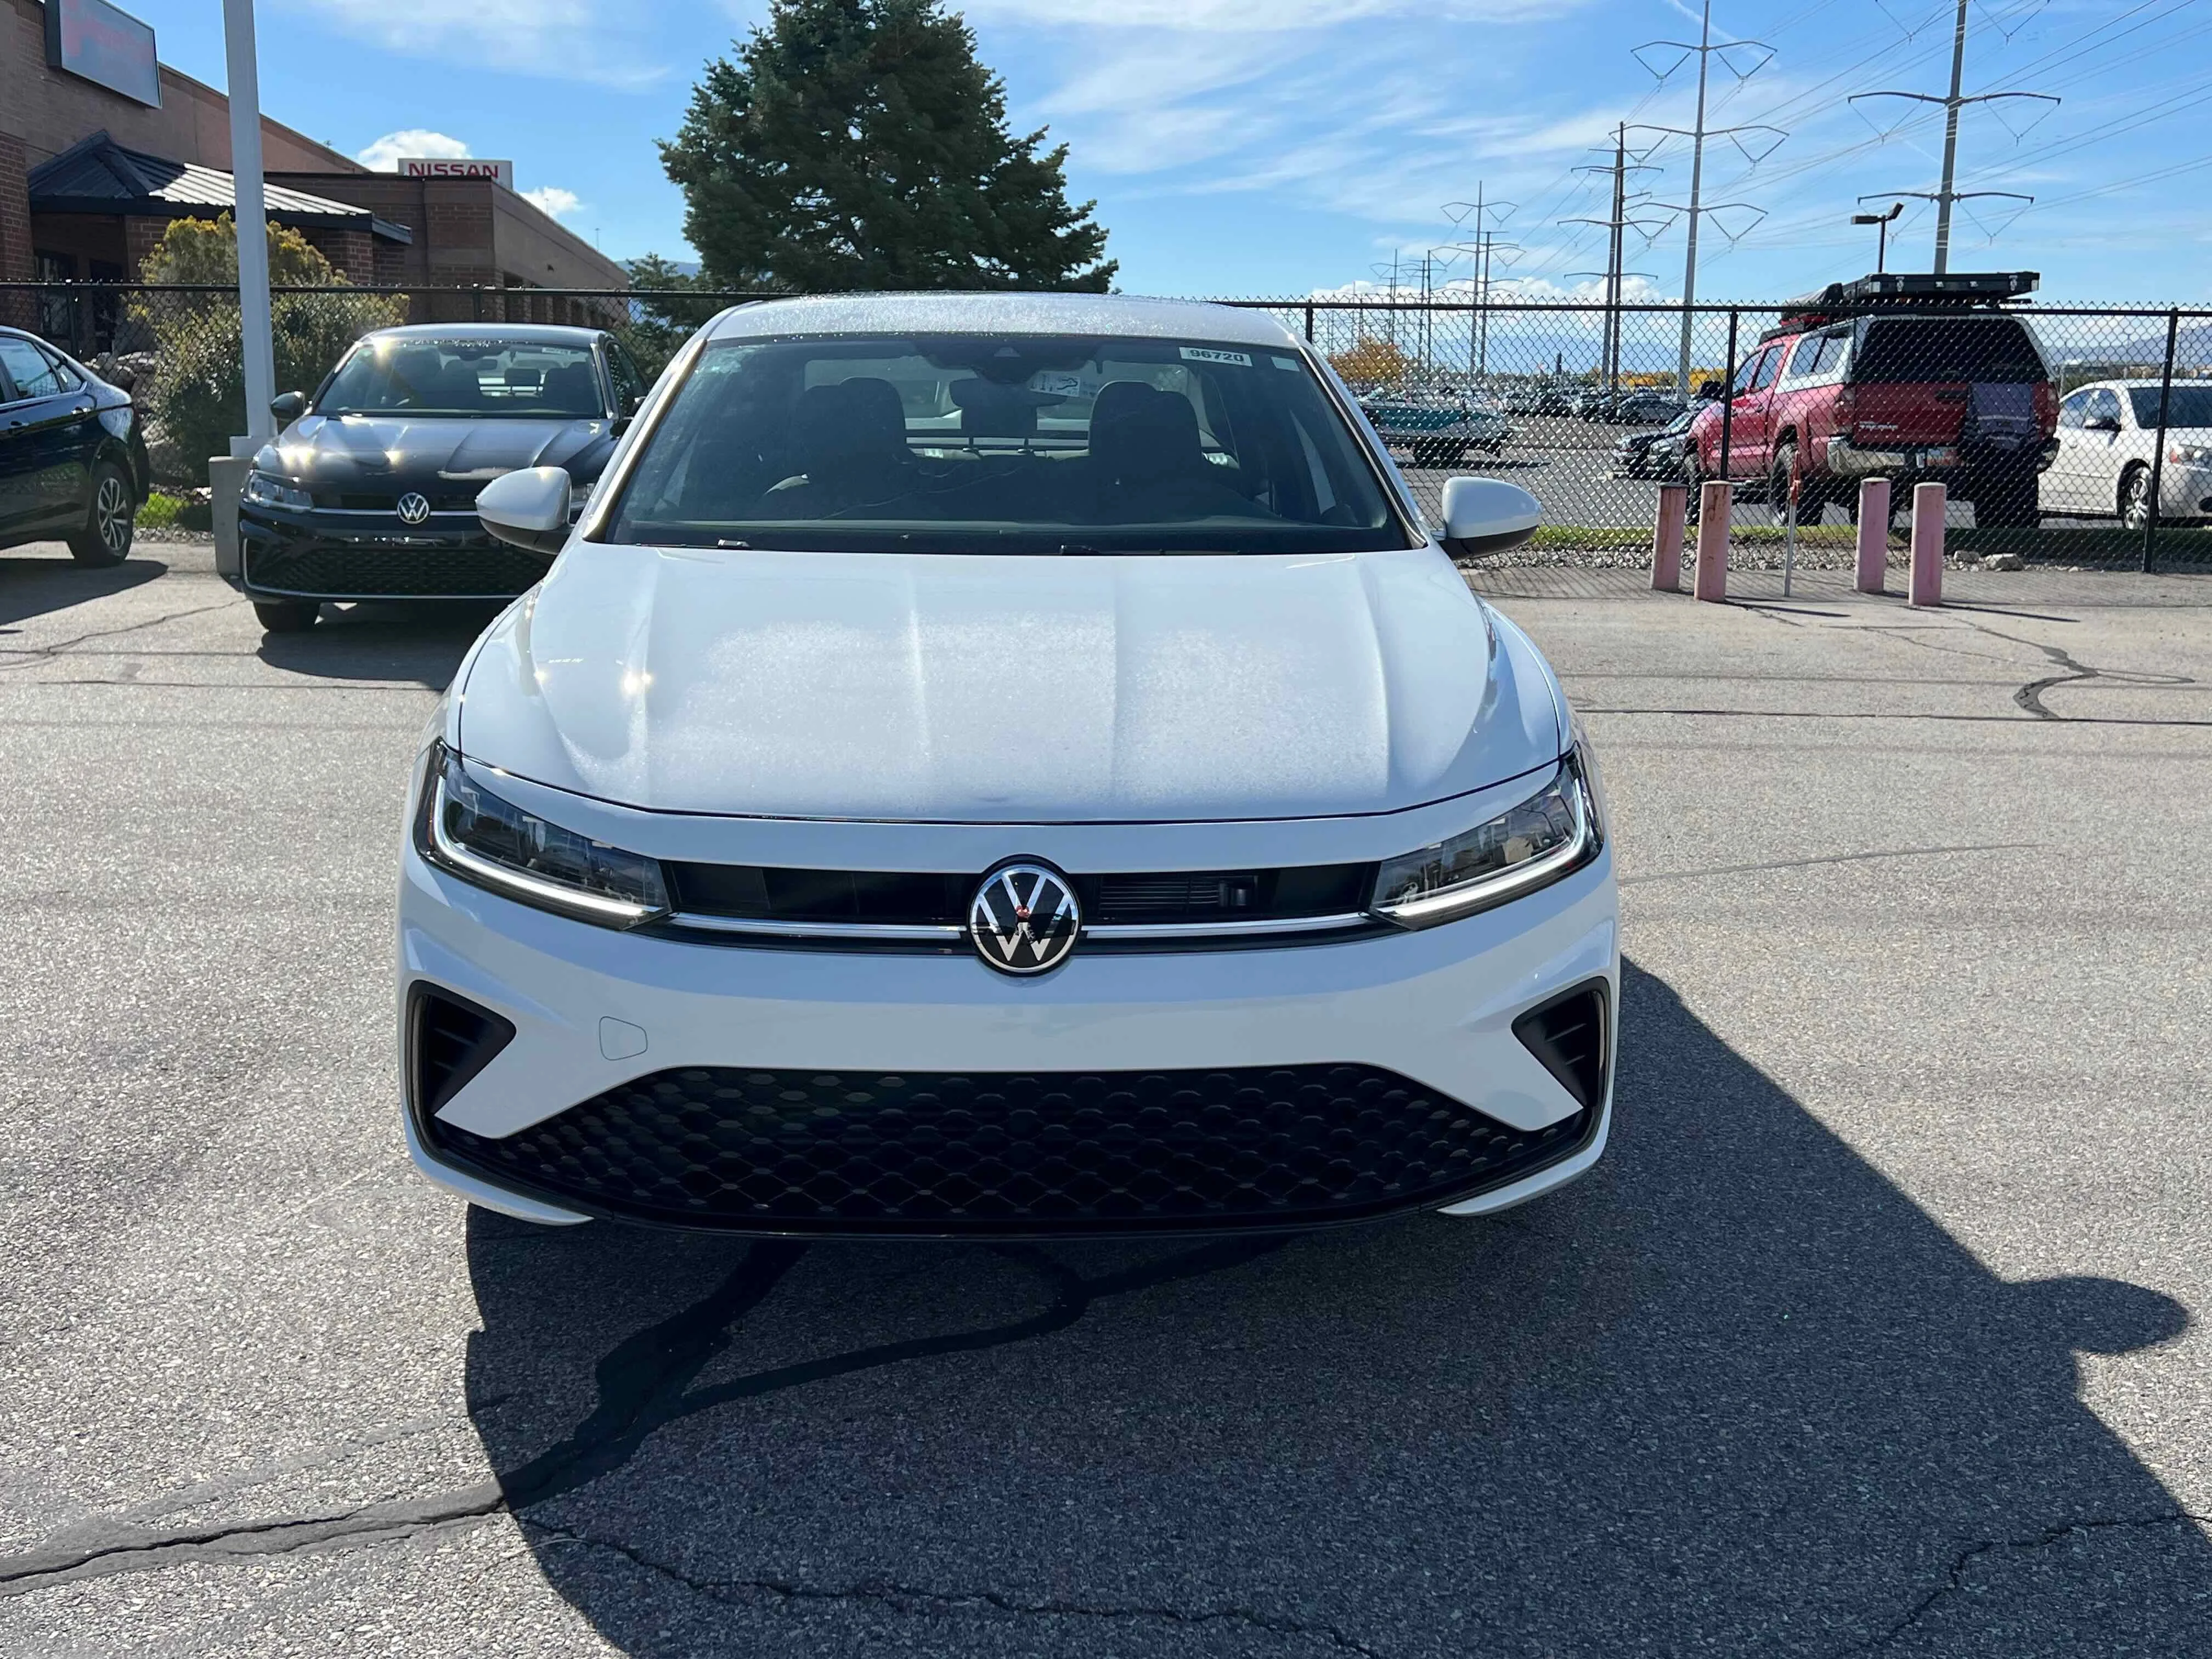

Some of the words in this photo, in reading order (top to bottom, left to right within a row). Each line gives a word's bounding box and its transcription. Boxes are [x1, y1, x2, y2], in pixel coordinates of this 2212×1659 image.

[409, 163, 498, 178] NISSAN
[1189, 349, 1244, 362] 96720
[974, 868, 1075, 966] VW
